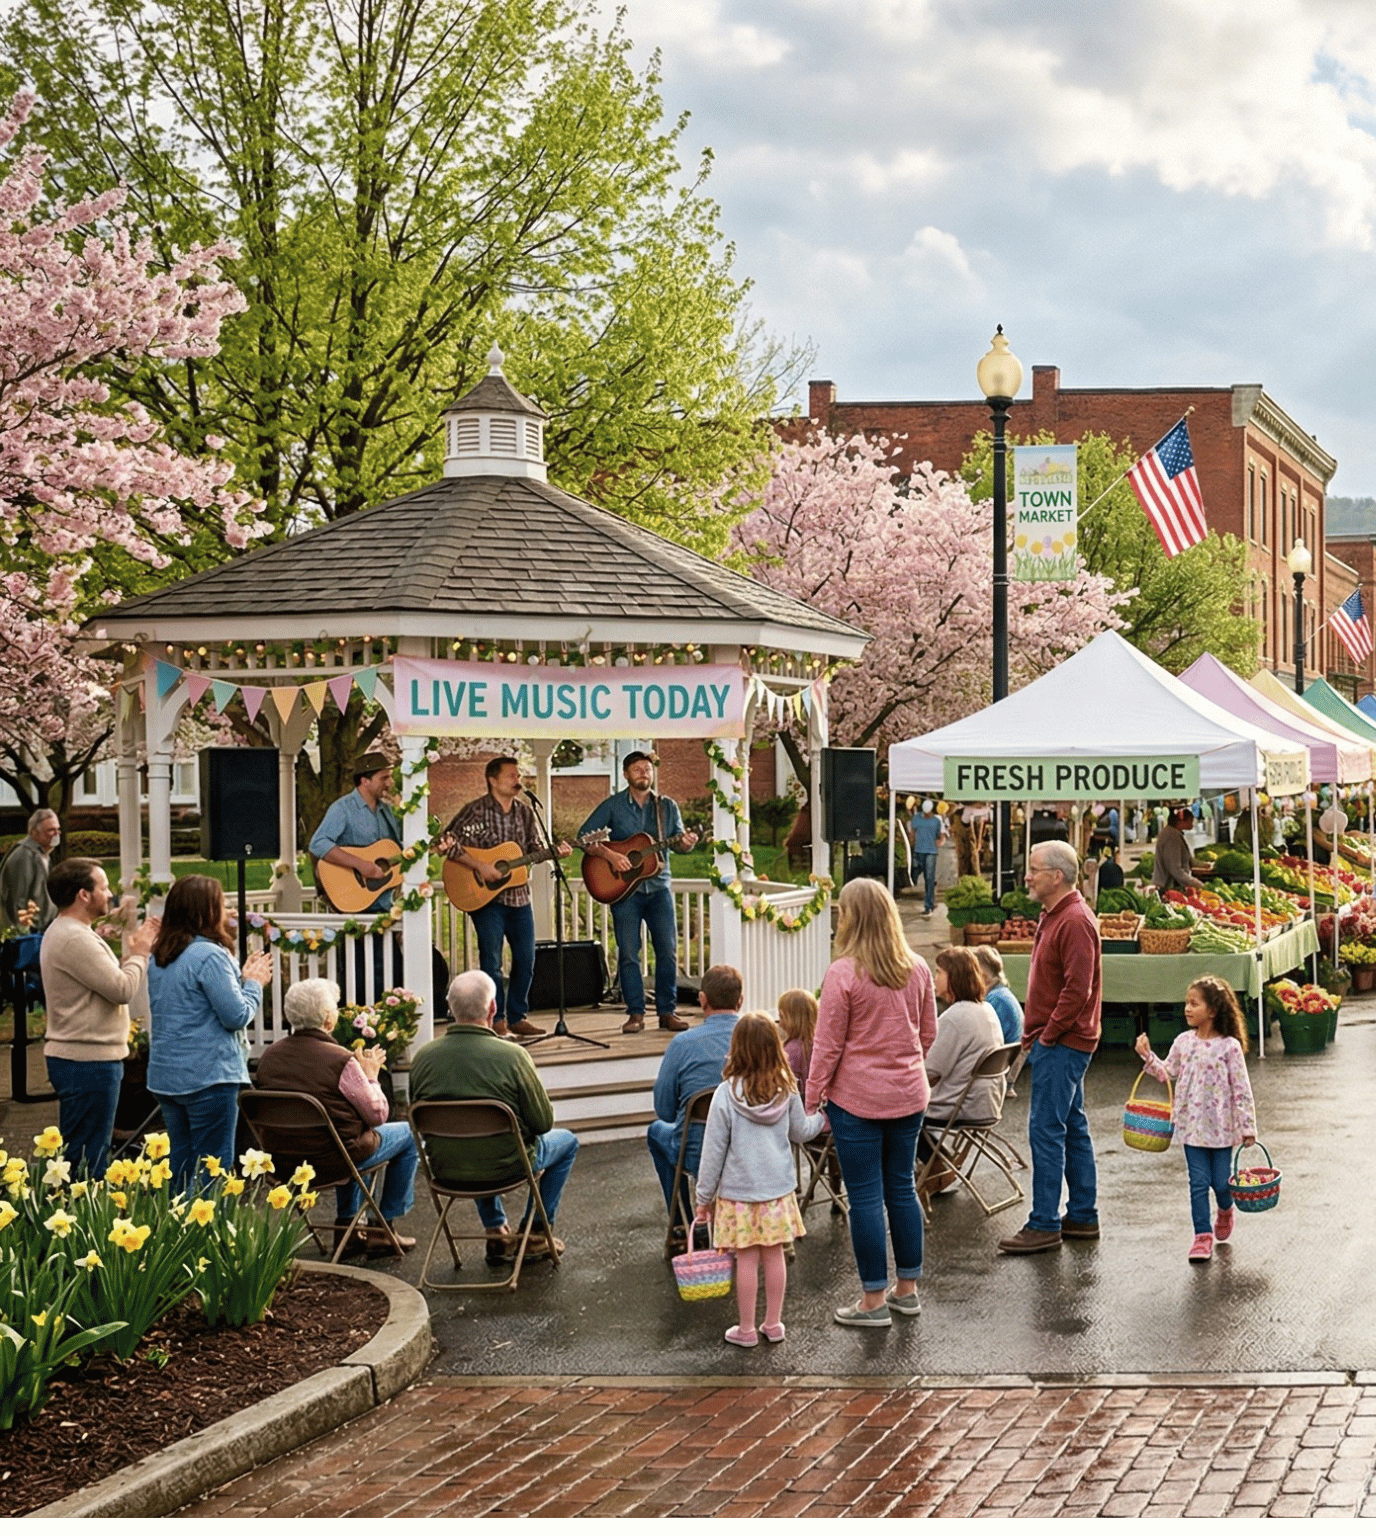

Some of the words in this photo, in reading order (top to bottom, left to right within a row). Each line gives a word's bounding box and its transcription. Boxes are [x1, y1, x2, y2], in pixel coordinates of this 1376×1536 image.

[1018, 491, 1072, 508] TOWN
[1019, 509, 1073, 523] MARKET
[410, 679, 488, 718] LIVE
[501, 683, 611, 719] MUSIC
[622, 684, 731, 719] TODAY
[957, 764, 1043, 791] FRESH
[1056, 763, 1186, 791] PRODUCE
